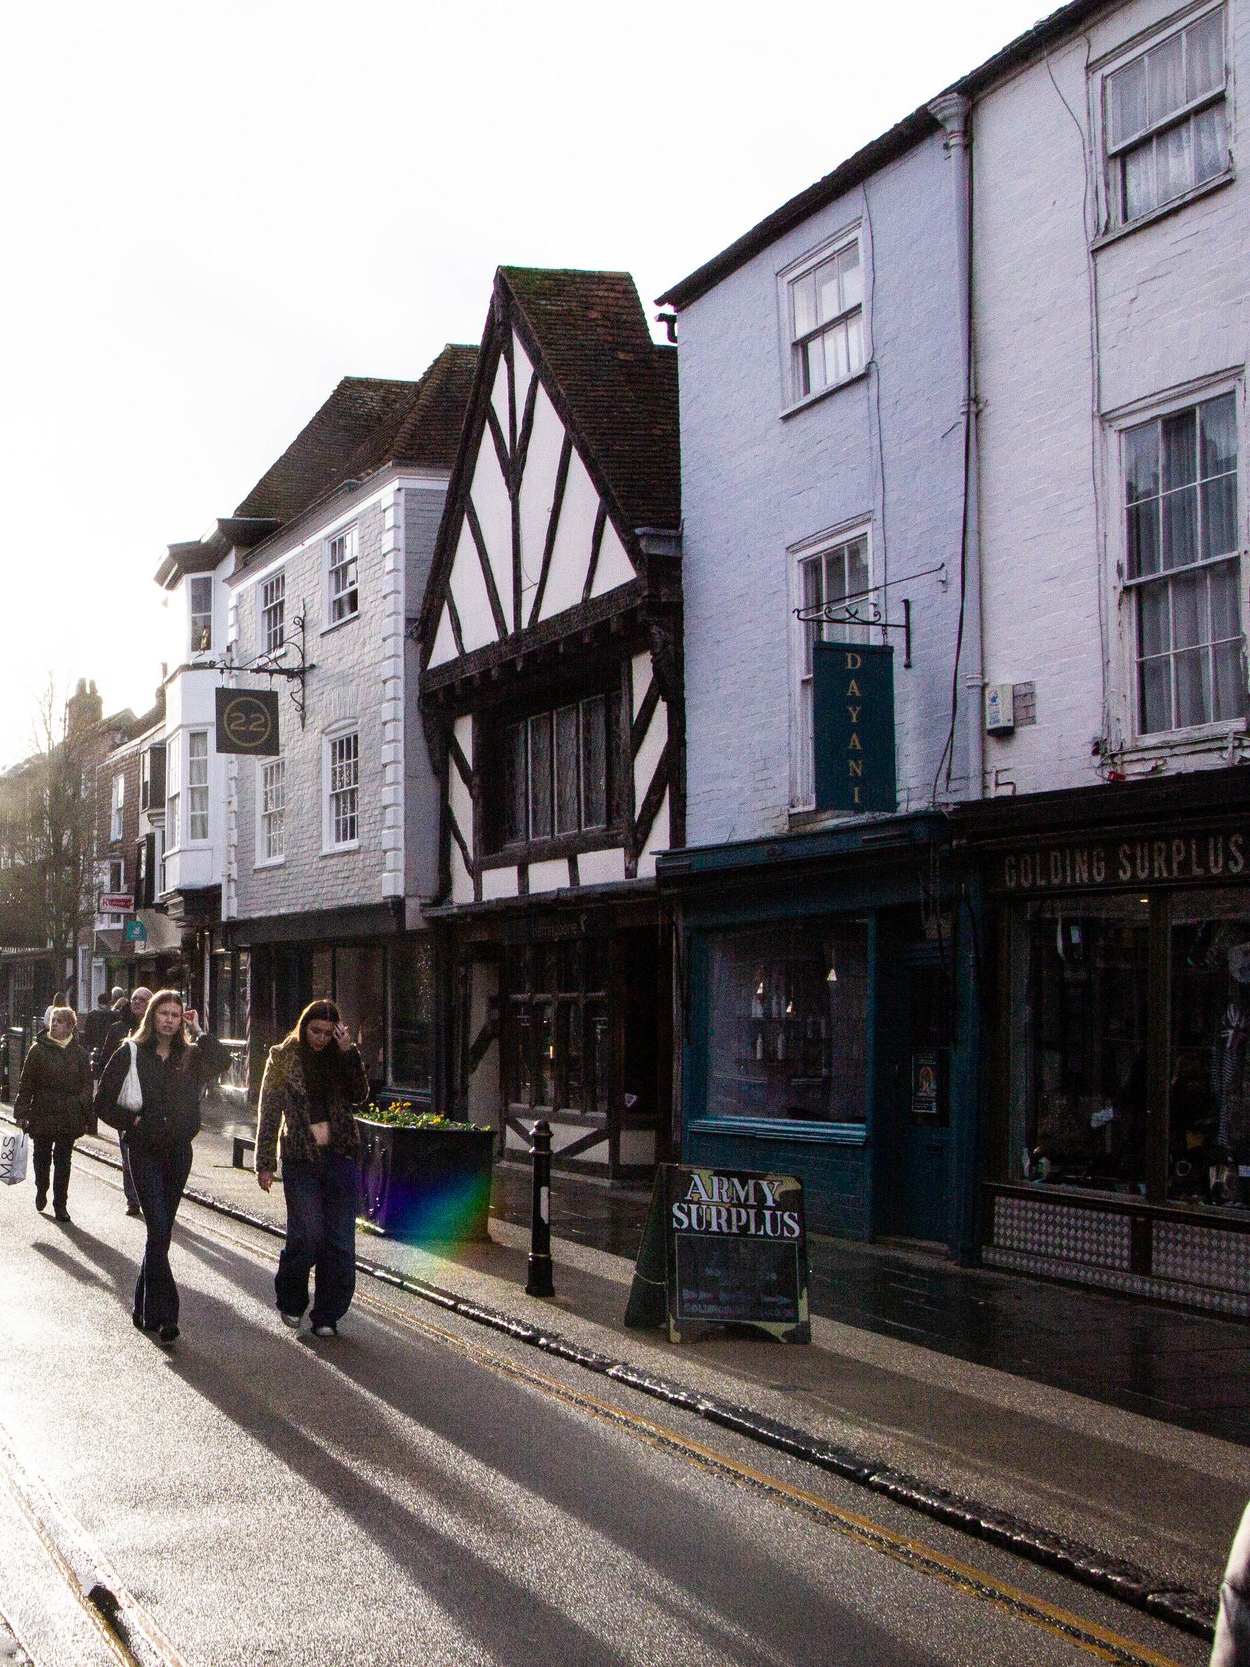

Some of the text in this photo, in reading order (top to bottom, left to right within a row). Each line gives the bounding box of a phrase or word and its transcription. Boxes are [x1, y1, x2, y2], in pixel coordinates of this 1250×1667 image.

[230, 712, 266, 731] 22
[845, 652, 863, 804] DAYANI
[1005, 833, 1244, 888] GOLDING SURPLUS
[0, 1136, 16, 1178] M&S
[684, 1174, 782, 1207] ARMY
[672, 1202, 800, 1238] SURPLUS
